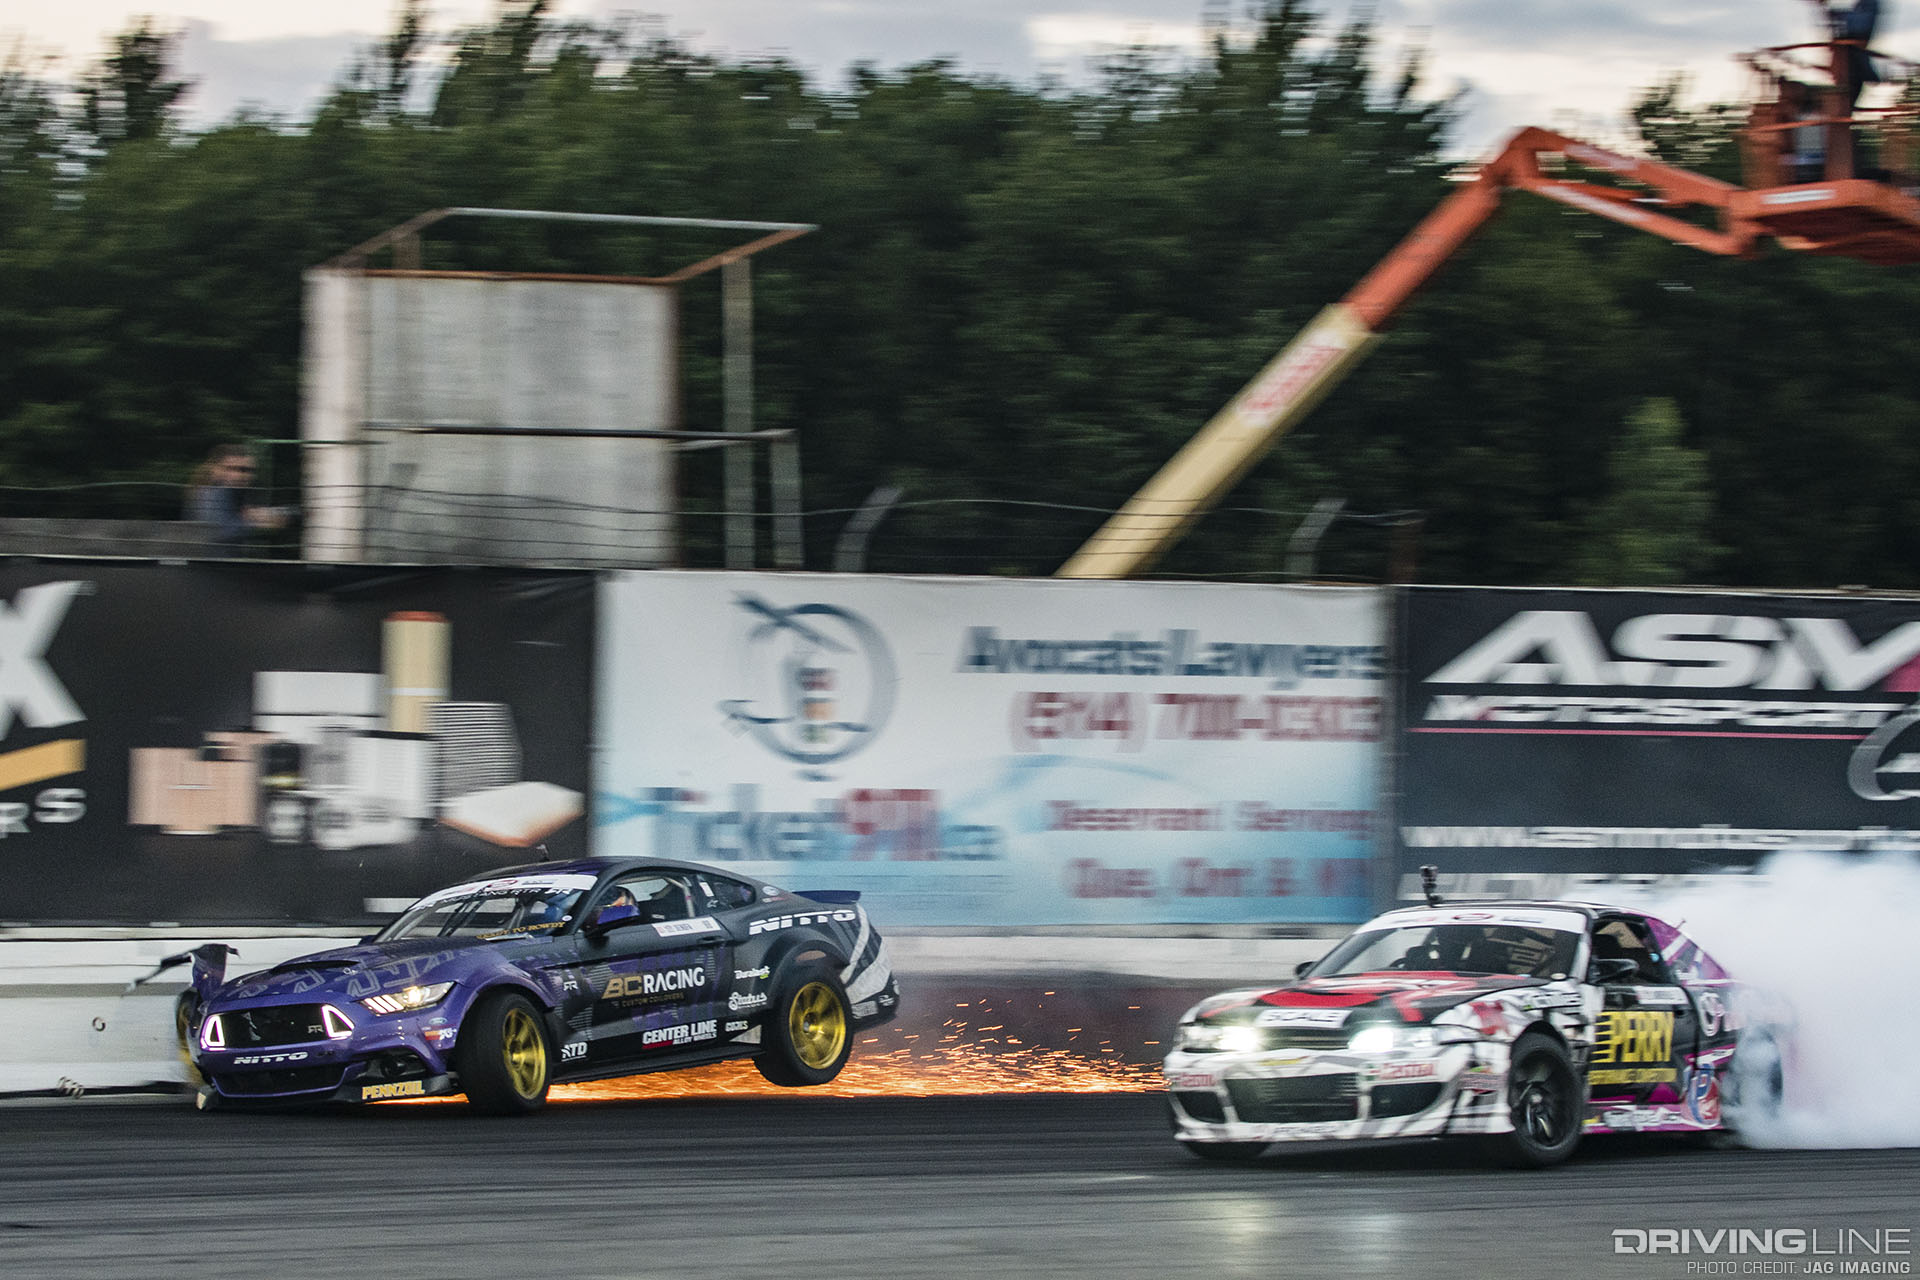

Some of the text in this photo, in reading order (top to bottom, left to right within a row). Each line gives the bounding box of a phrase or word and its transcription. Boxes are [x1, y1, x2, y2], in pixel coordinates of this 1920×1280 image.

[749, 909, 857, 936] NITTO
[642, 1019, 718, 1045] CENTER LINE
[1606, 1011, 1675, 1063] PERRY
[233, 1052, 309, 1065] NITTO
[362, 1080, 425, 1100] PENNZOIL
